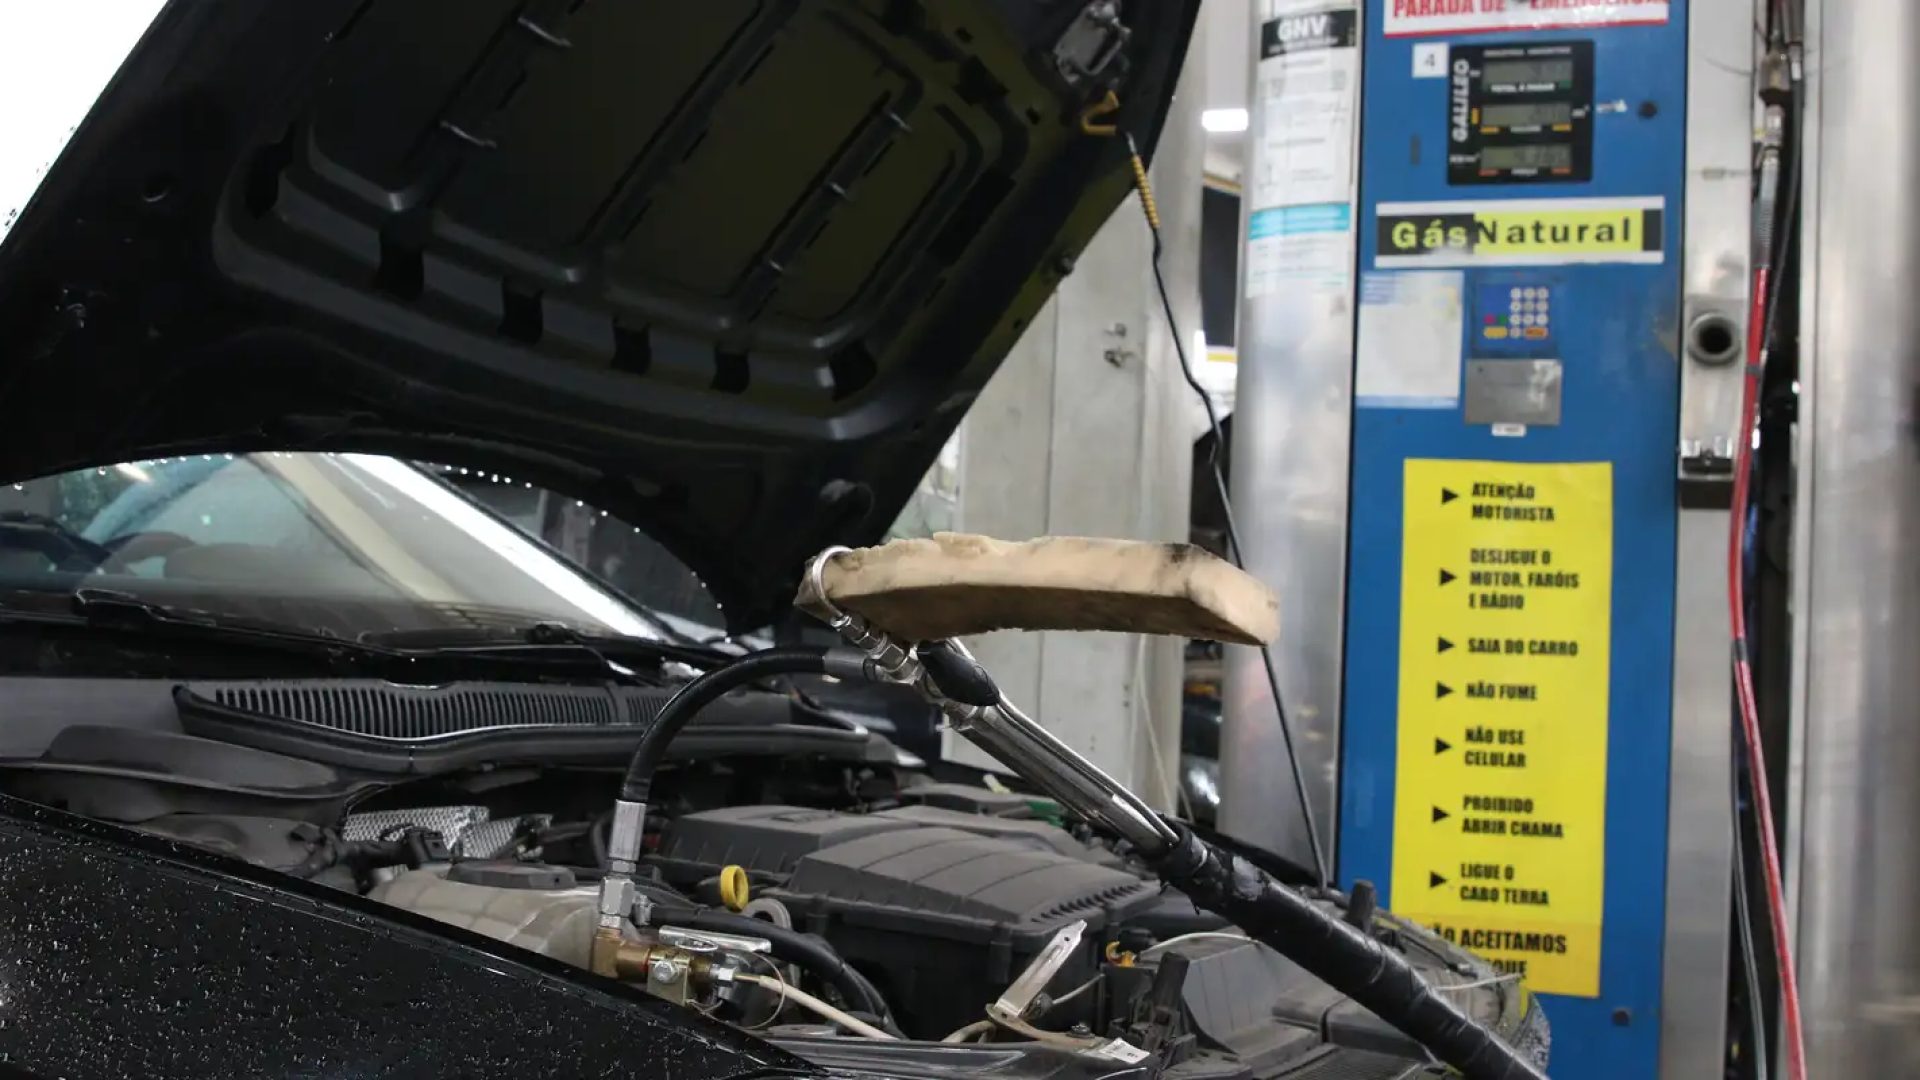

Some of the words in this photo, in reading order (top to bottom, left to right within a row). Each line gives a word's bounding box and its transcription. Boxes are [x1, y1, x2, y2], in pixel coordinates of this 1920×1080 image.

[1393, 0, 1474, 17] PARADA
[1276, 14, 1328, 42] GNV
[1424, 53, 1436, 69] 4
[1451, 58, 1470, 142] GALILEO
[1391, 219, 1467, 249] Gás
[1475, 217, 1630, 244] Natural
[1471, 482, 1535, 500] ATENÇÃO
[1471, 505, 1555, 521] MOTORISTA
[1470, 549, 1538, 565] DESLIGUE
[1542, 550, 1552, 565] O
[1528, 570, 1580, 588] FARÓIS
[1469, 593, 1476, 609] E
[1480, 592, 1525, 609] RÁDIO
[1468, 638, 1501, 653] SAIA
[1504, 639, 1524, 654] DO
[1528, 640, 1579, 656] CARRO
[1466, 680, 1495, 698] NÃO
[1499, 684, 1538, 700] FUME
[1465, 725, 1494, 744] NÃO
[1498, 730, 1525, 745] USE
[1464, 751, 1527, 767] CELULAR
[1463, 795, 1534, 813] PROIBIDO
[1462, 818, 1507, 834] ABRIR
[1510, 821, 1563, 838] CHAMA
[1460, 863, 1500, 880] LIGUE
[1504, 865, 1514, 880] O
[1460, 886, 1500, 902] CABO
[1504, 888, 1549, 905] TERRA
[1461, 929, 1567, 954] ACEITAMOS
